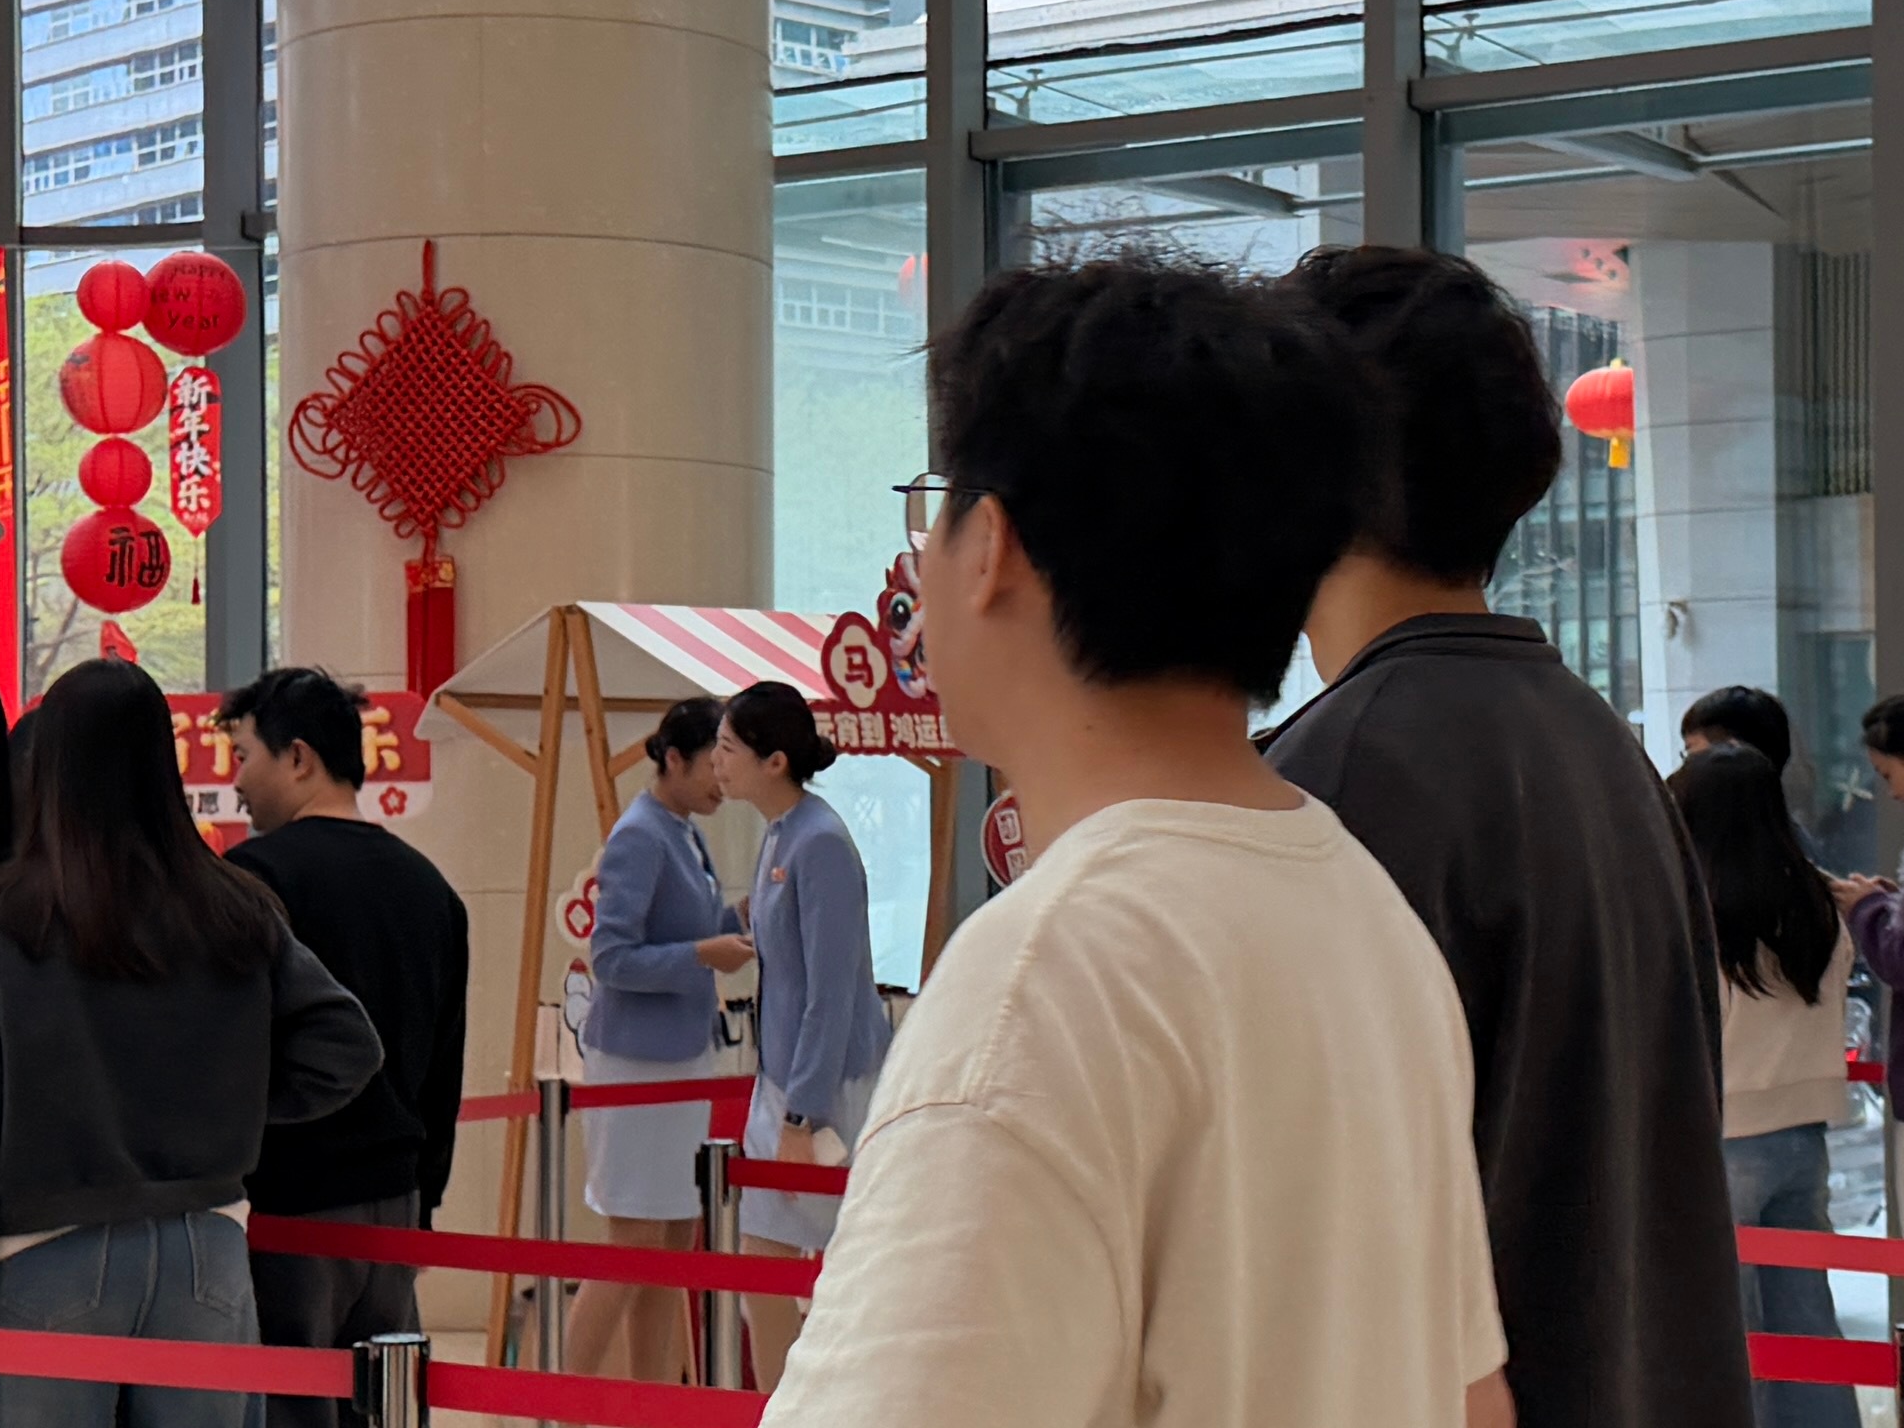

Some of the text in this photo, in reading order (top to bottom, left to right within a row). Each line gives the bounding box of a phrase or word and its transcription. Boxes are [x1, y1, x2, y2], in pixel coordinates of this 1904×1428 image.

[173, 373, 213, 512] 新年快乐
[105, 527, 166, 588] 福
[844, 645, 874, 688] 马
